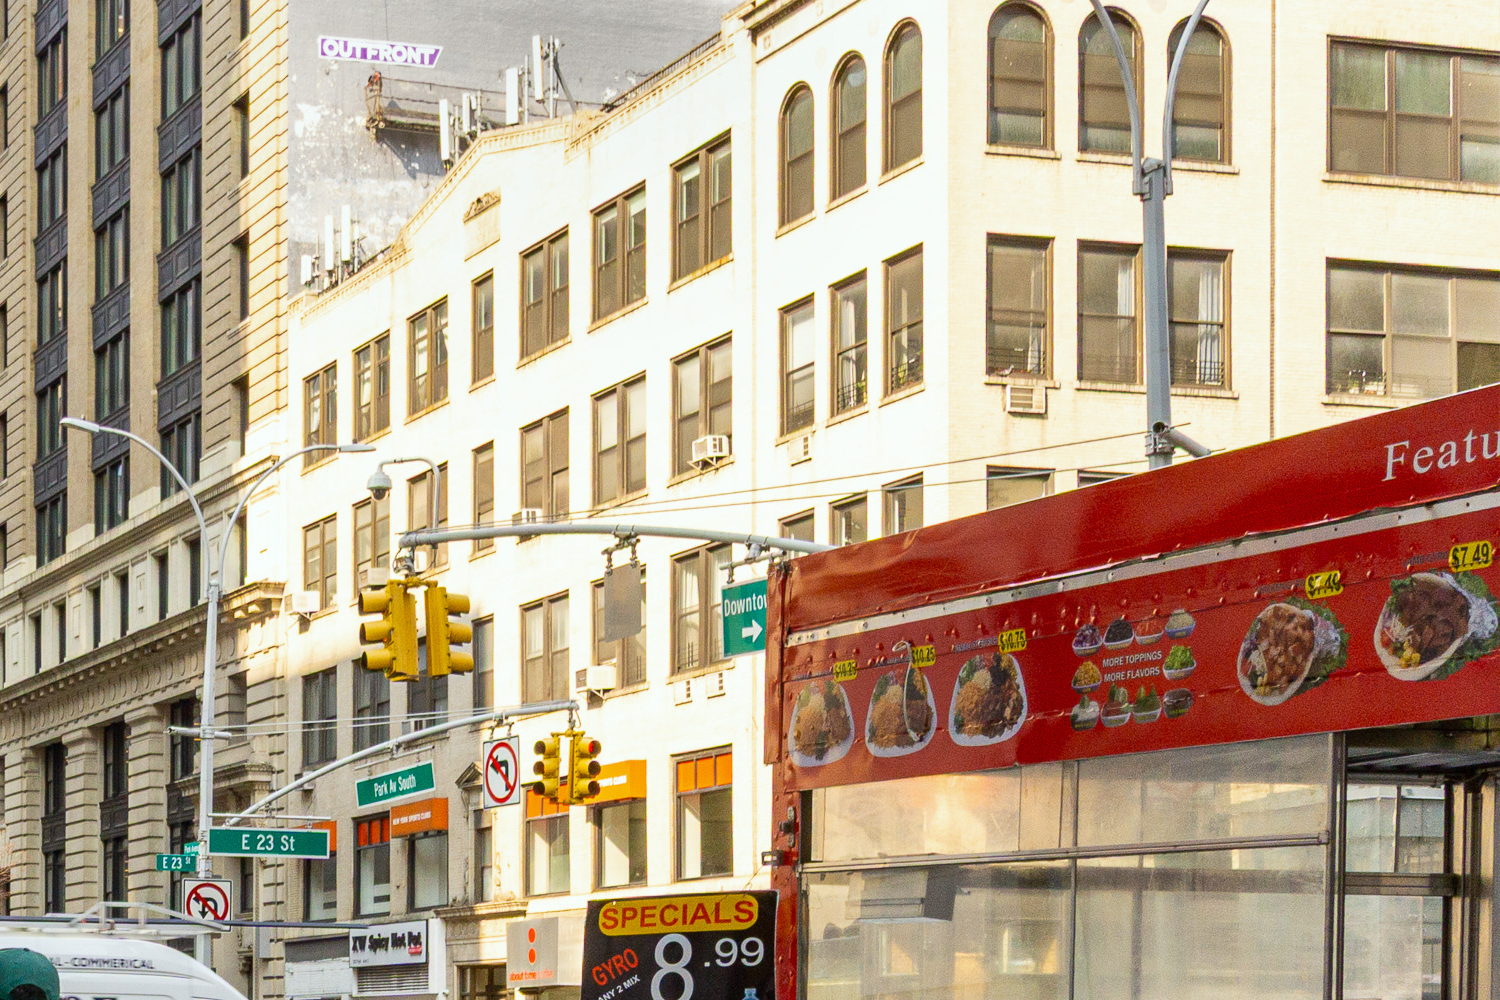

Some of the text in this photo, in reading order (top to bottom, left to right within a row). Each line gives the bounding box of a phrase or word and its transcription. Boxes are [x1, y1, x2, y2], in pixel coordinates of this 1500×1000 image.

[322, 38, 437, 66] OUTFRONT
[1451, 543, 1490, 569] $7.49
[1308, 573, 1340, 598] $7.49
[1102, 650, 1162, 668] MORE TOPPINGS
[1104, 666, 1160, 683] MORE FLAVORS
[373, 774, 417, 798] Park Av South
[242, 834, 296, 852] E 23 St
[162, 856, 169, 869] E
[171, 857, 183, 870] 23
[601, 900, 755, 930] SPECIALS
[592, 947, 640, 987] GYRO
[617, 984, 624, 995] 2
[624, 974, 641, 991] MIX
